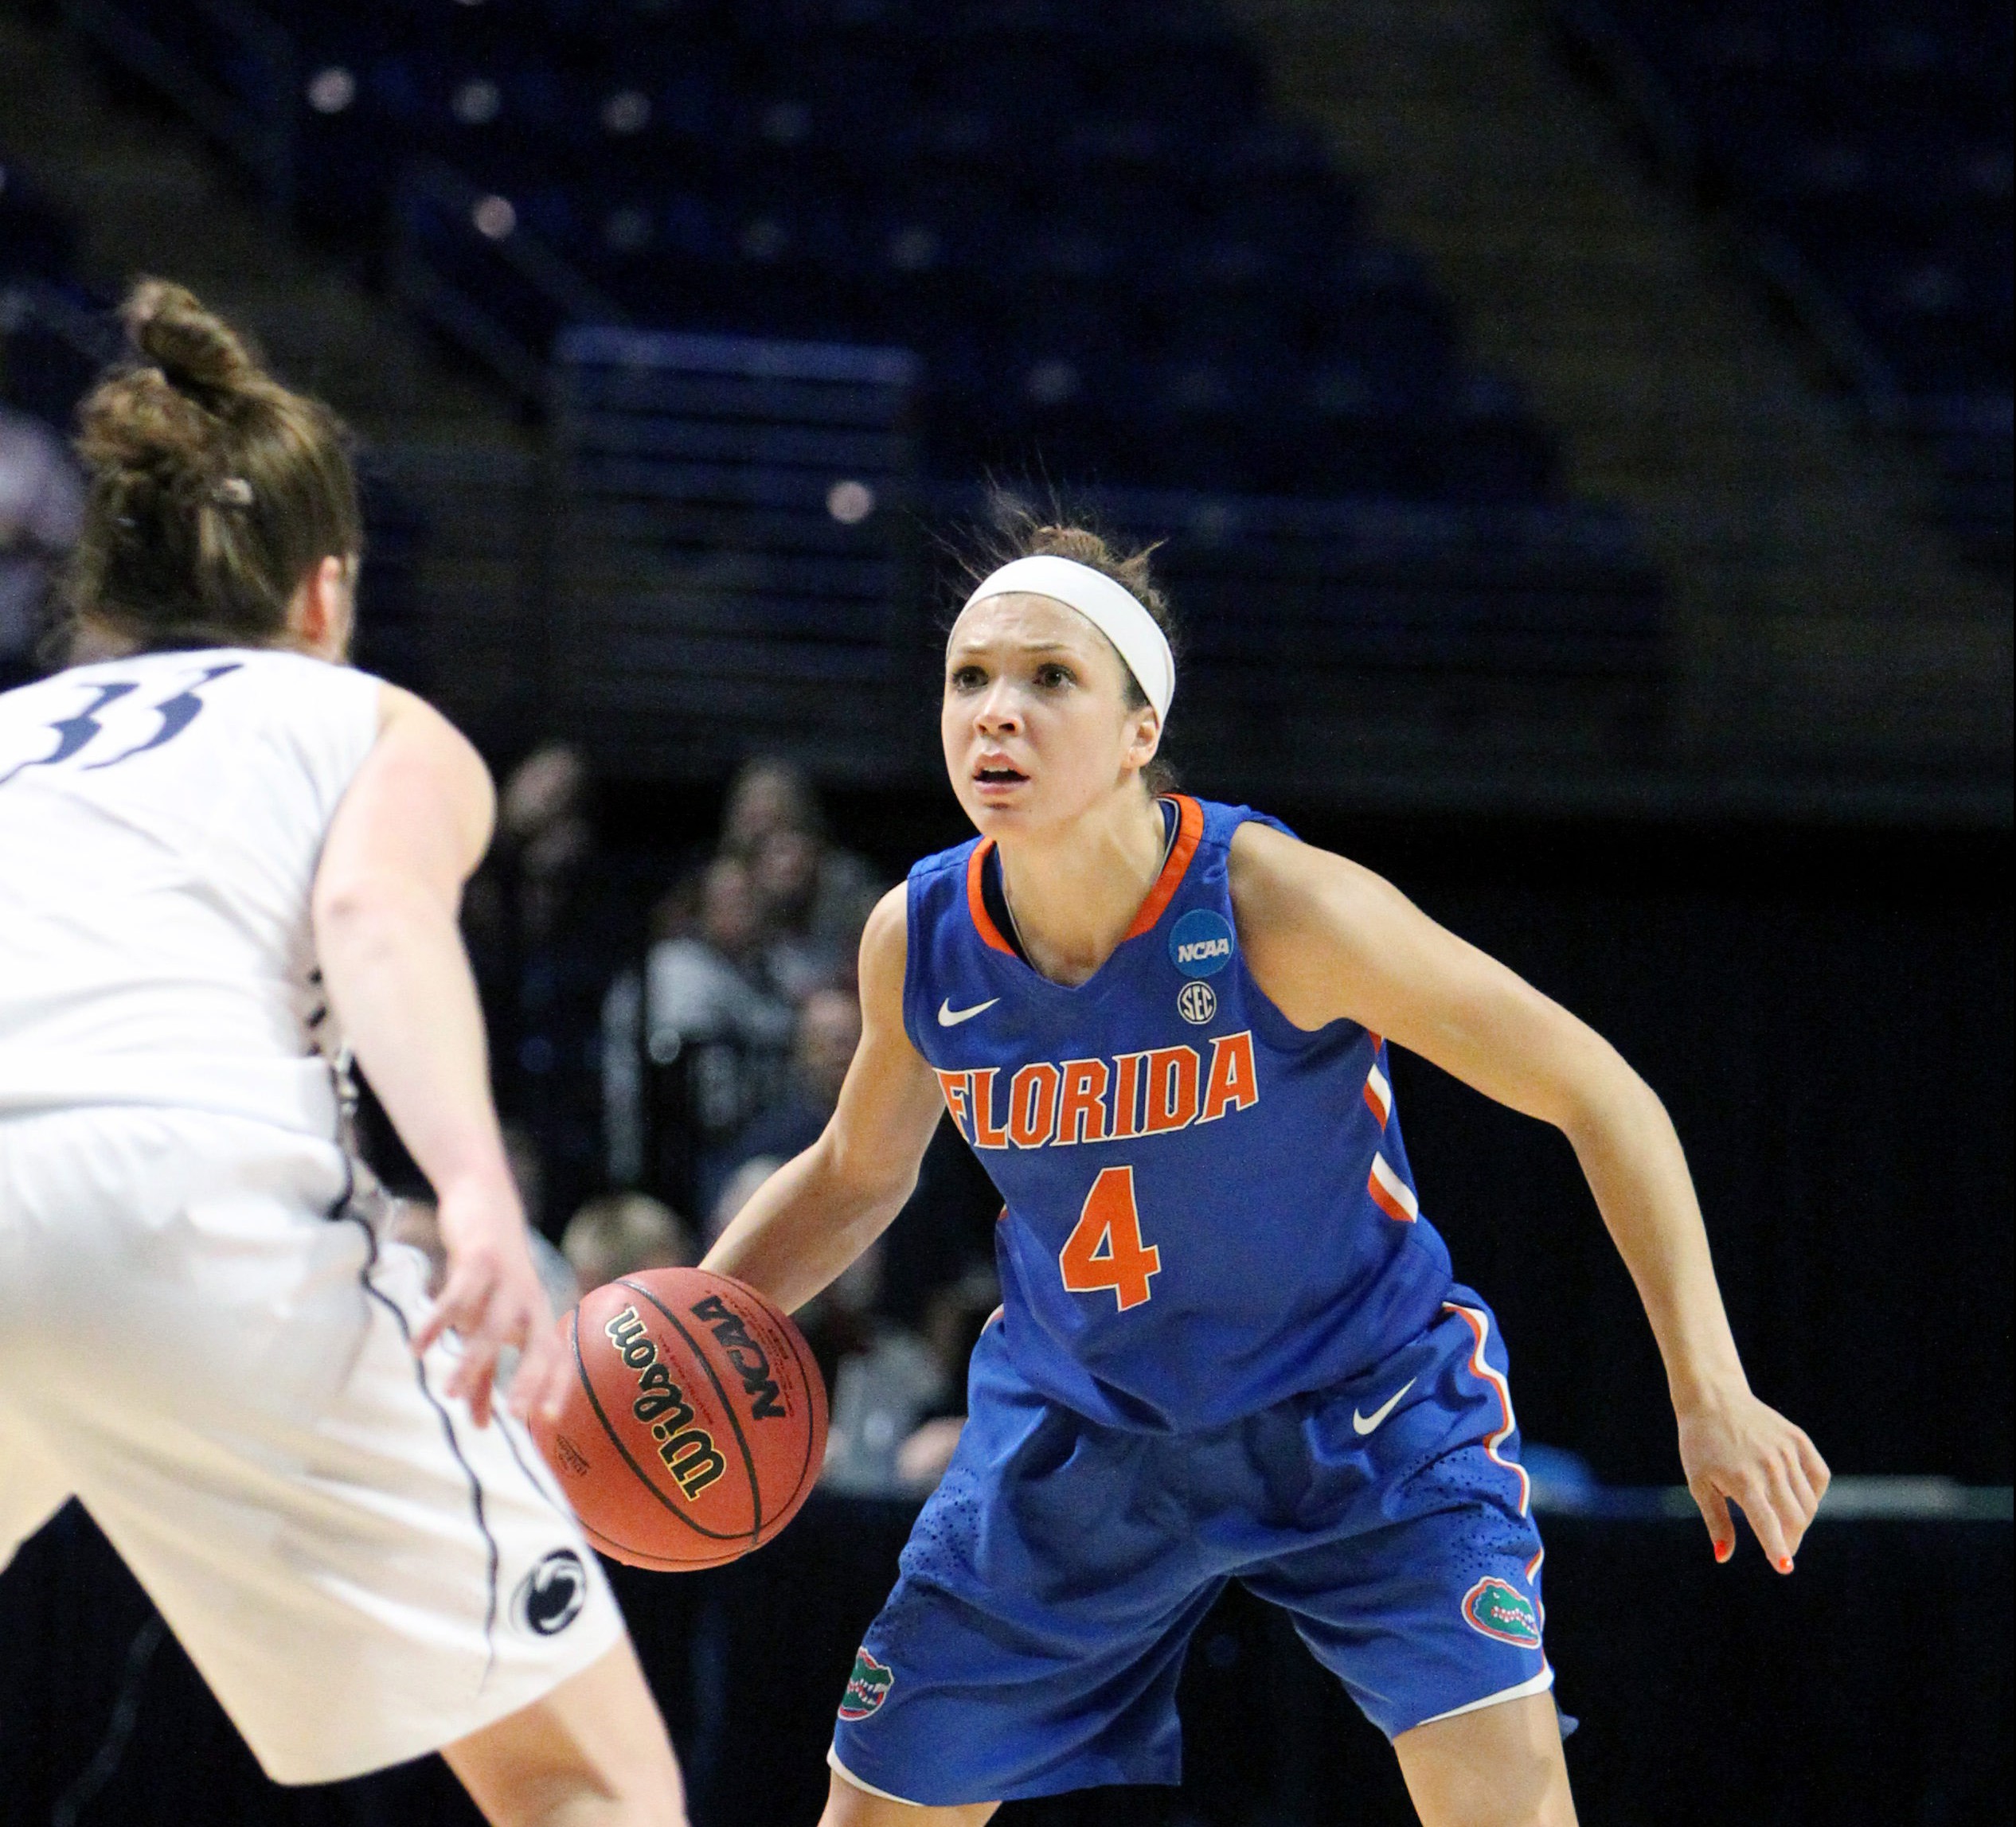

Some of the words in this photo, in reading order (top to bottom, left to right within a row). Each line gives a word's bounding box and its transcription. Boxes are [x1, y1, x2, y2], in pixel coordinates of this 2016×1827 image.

[0, 662, 244, 785] 33
[1178, 937, 1229, 963] NCAA
[1182, 985, 1213, 1021] SEC
[932, 1030, 1259, 1150] FLORIDA
[1059, 1165, 1161, 1312] 4
[604, 1305, 727, 1502] Wilson
[690, 1295, 787, 1420] NCAA
